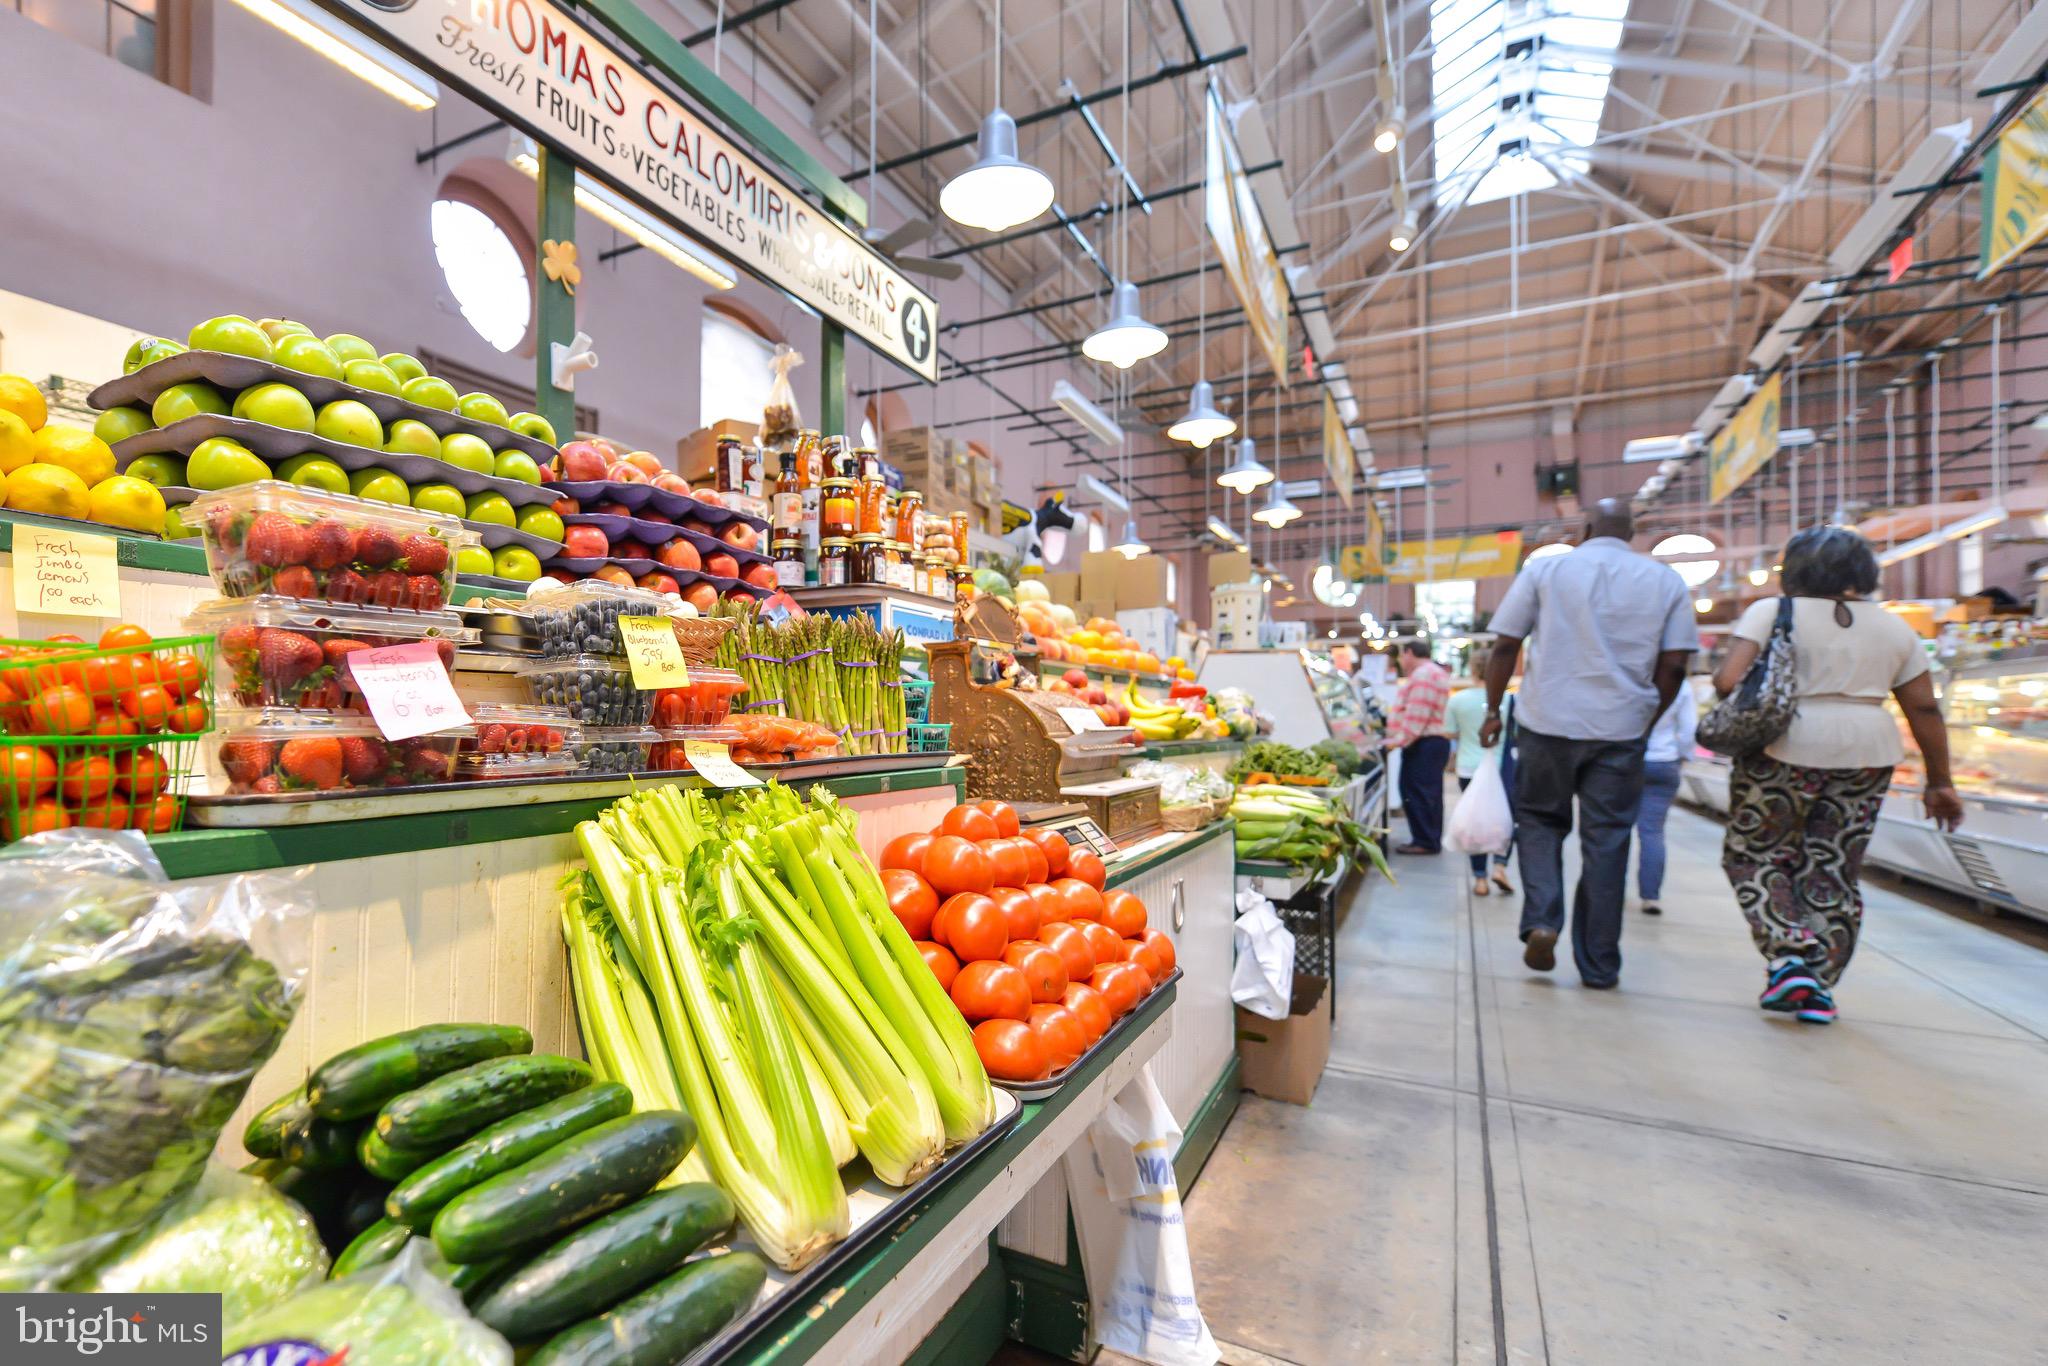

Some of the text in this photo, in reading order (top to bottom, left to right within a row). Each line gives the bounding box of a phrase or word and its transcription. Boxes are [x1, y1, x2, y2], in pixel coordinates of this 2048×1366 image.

[436, 15, 527, 95] Fresh
[536, 78, 615, 156] FRUITS
[618, 143, 629, 160] &
[631, 144, 746, 243] VEGETABLES
[848, 292, 894, 341] RETAIL
[645, 100, 810, 253] CALOMIRIS
[905, 302, 927, 358] 4
[34, 534, 81, 558] Fresh
[69, 593, 103, 606] each
[629, 617, 655, 632] Fresh
[369, 650, 408, 668] Fresh
